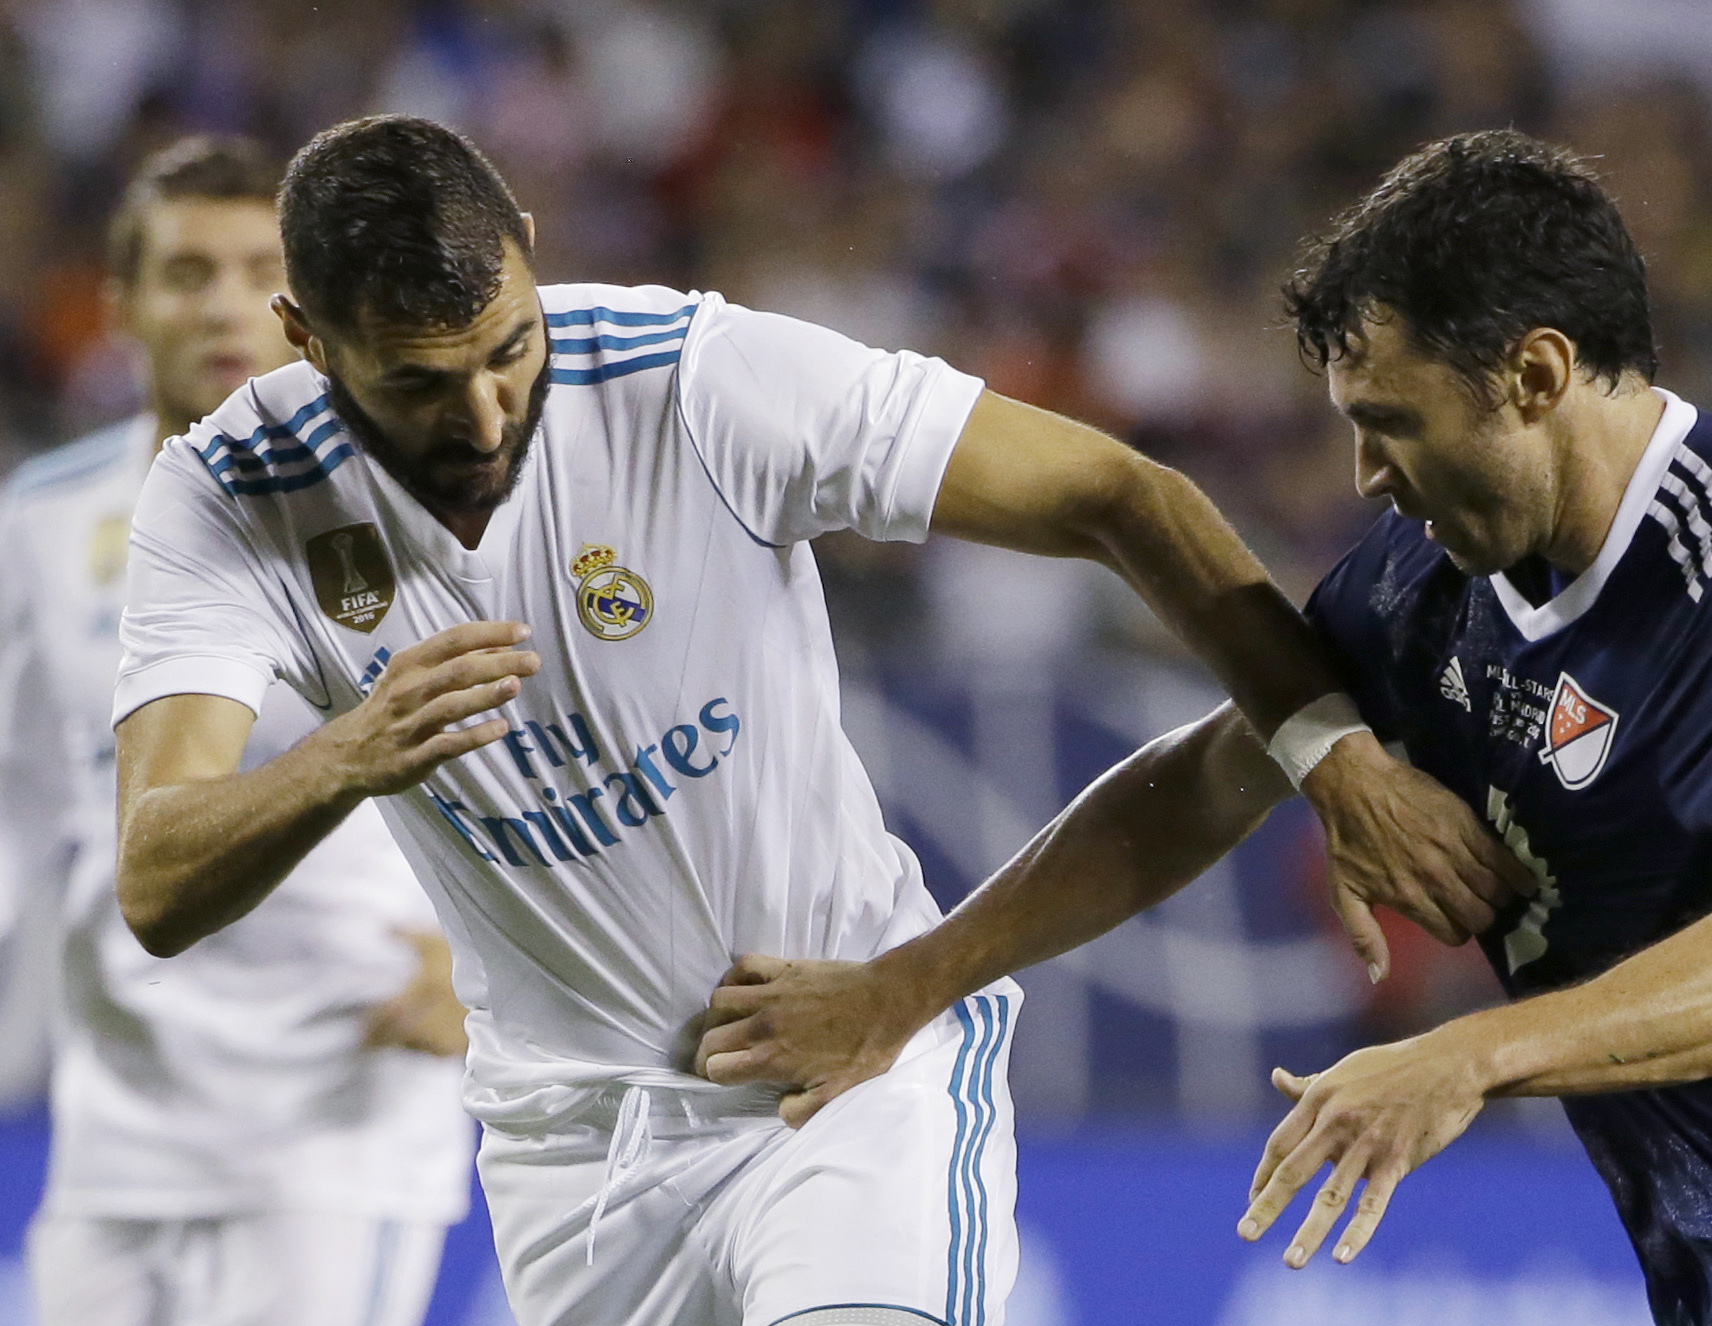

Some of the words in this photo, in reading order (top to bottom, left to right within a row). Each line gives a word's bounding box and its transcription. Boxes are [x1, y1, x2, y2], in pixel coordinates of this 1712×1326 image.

[341, 592, 379, 611] FIFA
[1559, 689, 1587, 725] MLS
[503, 712, 600, 780] Fly
[429, 697, 740, 868] Emirates
